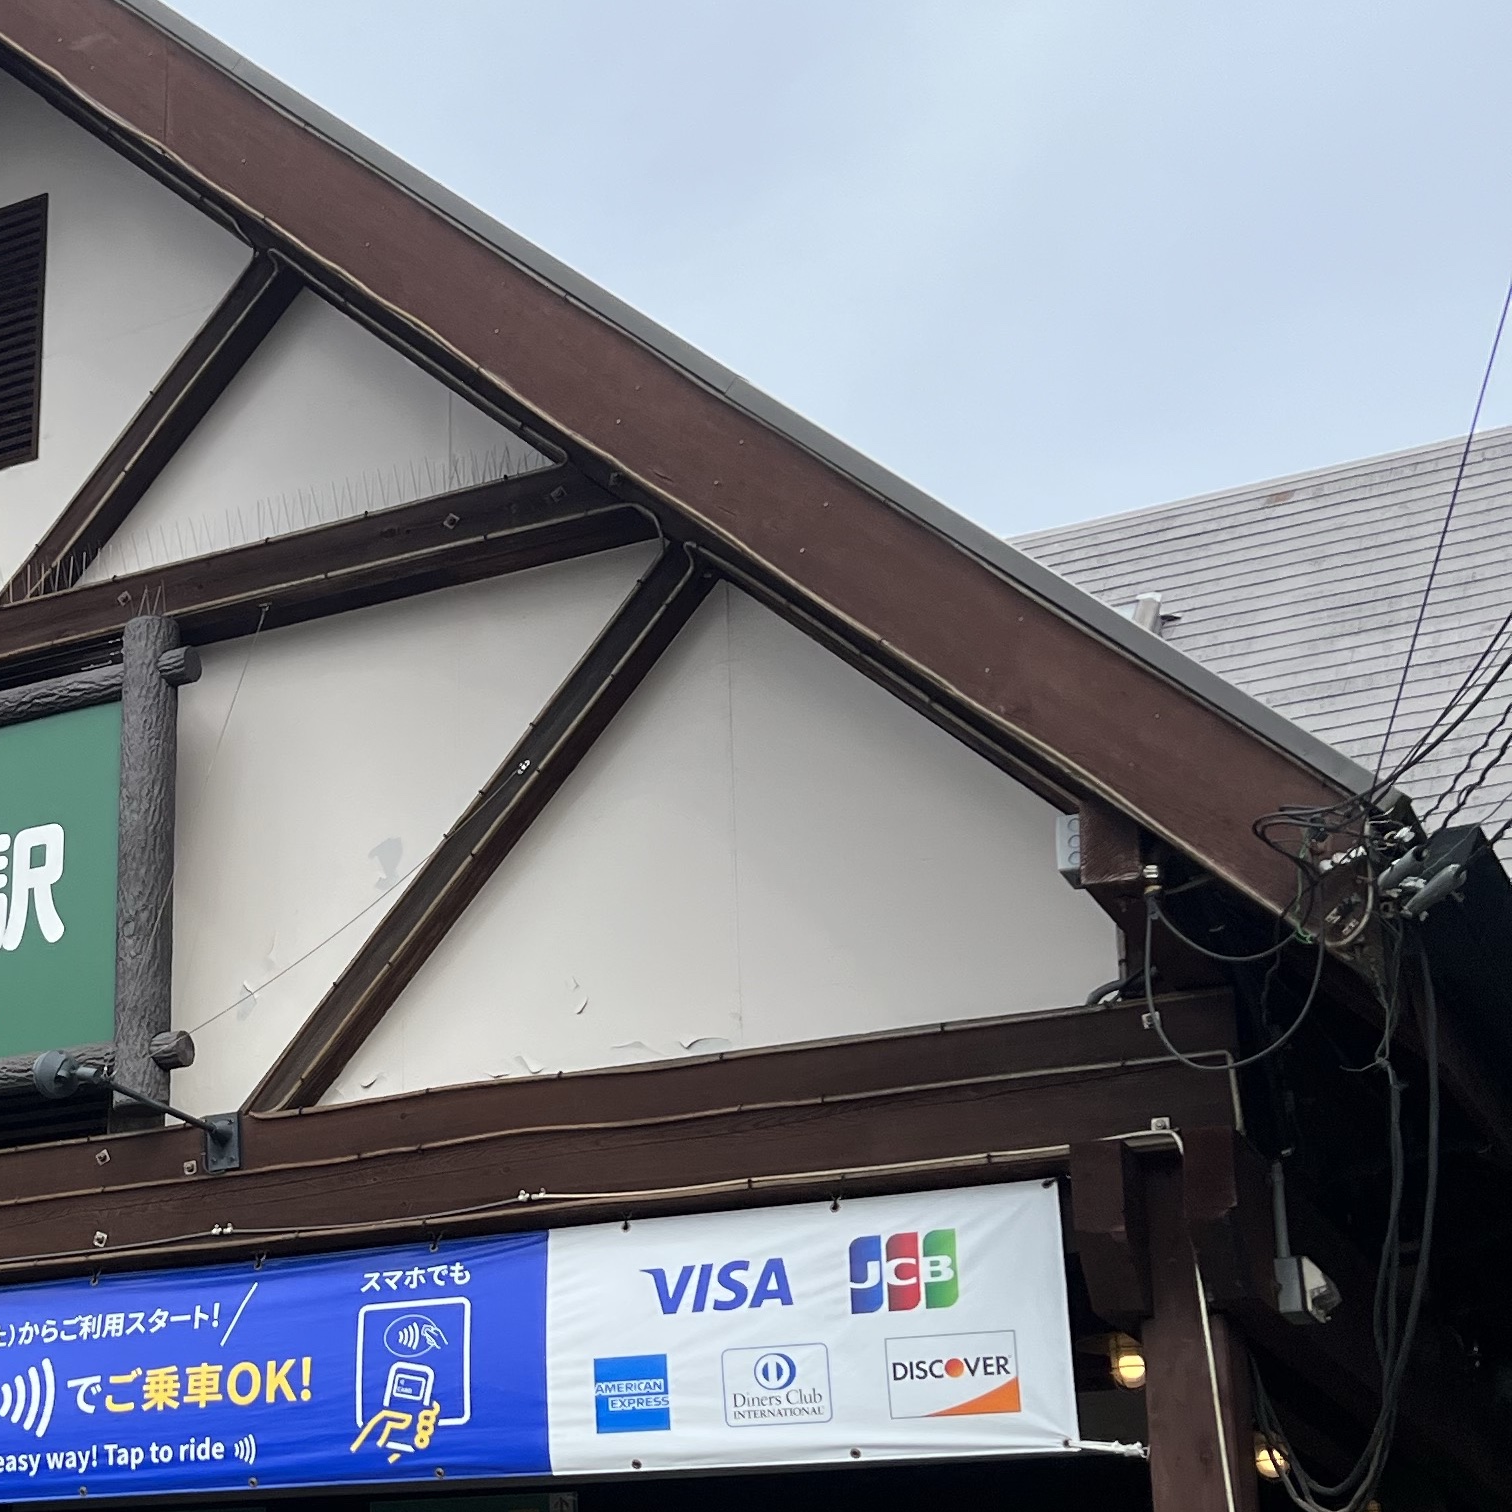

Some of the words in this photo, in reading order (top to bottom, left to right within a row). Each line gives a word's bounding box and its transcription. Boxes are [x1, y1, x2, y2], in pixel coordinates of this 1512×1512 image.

[360, 1262, 471, 1294] スマホでも
[640, 1257, 794, 1315] VISA
[849, 1243, 958, 1300] JCB
[892, 1355, 1011, 1382] DISCOVER
[595, 1380, 664, 1395] AMERICAN
[732, 1391, 782, 1408] Diners
[787, 1388, 823, 1406] Club
[609, 1395, 670, 1411] EXPRESS
[733, 1406, 825, 1420] INTERNATIONAL
[46, 1446, 99, 1473] way!
[104, 1443, 143, 1471] Tap
[149, 1439, 172, 1461] to
[178, 1435, 224, 1461] ride
